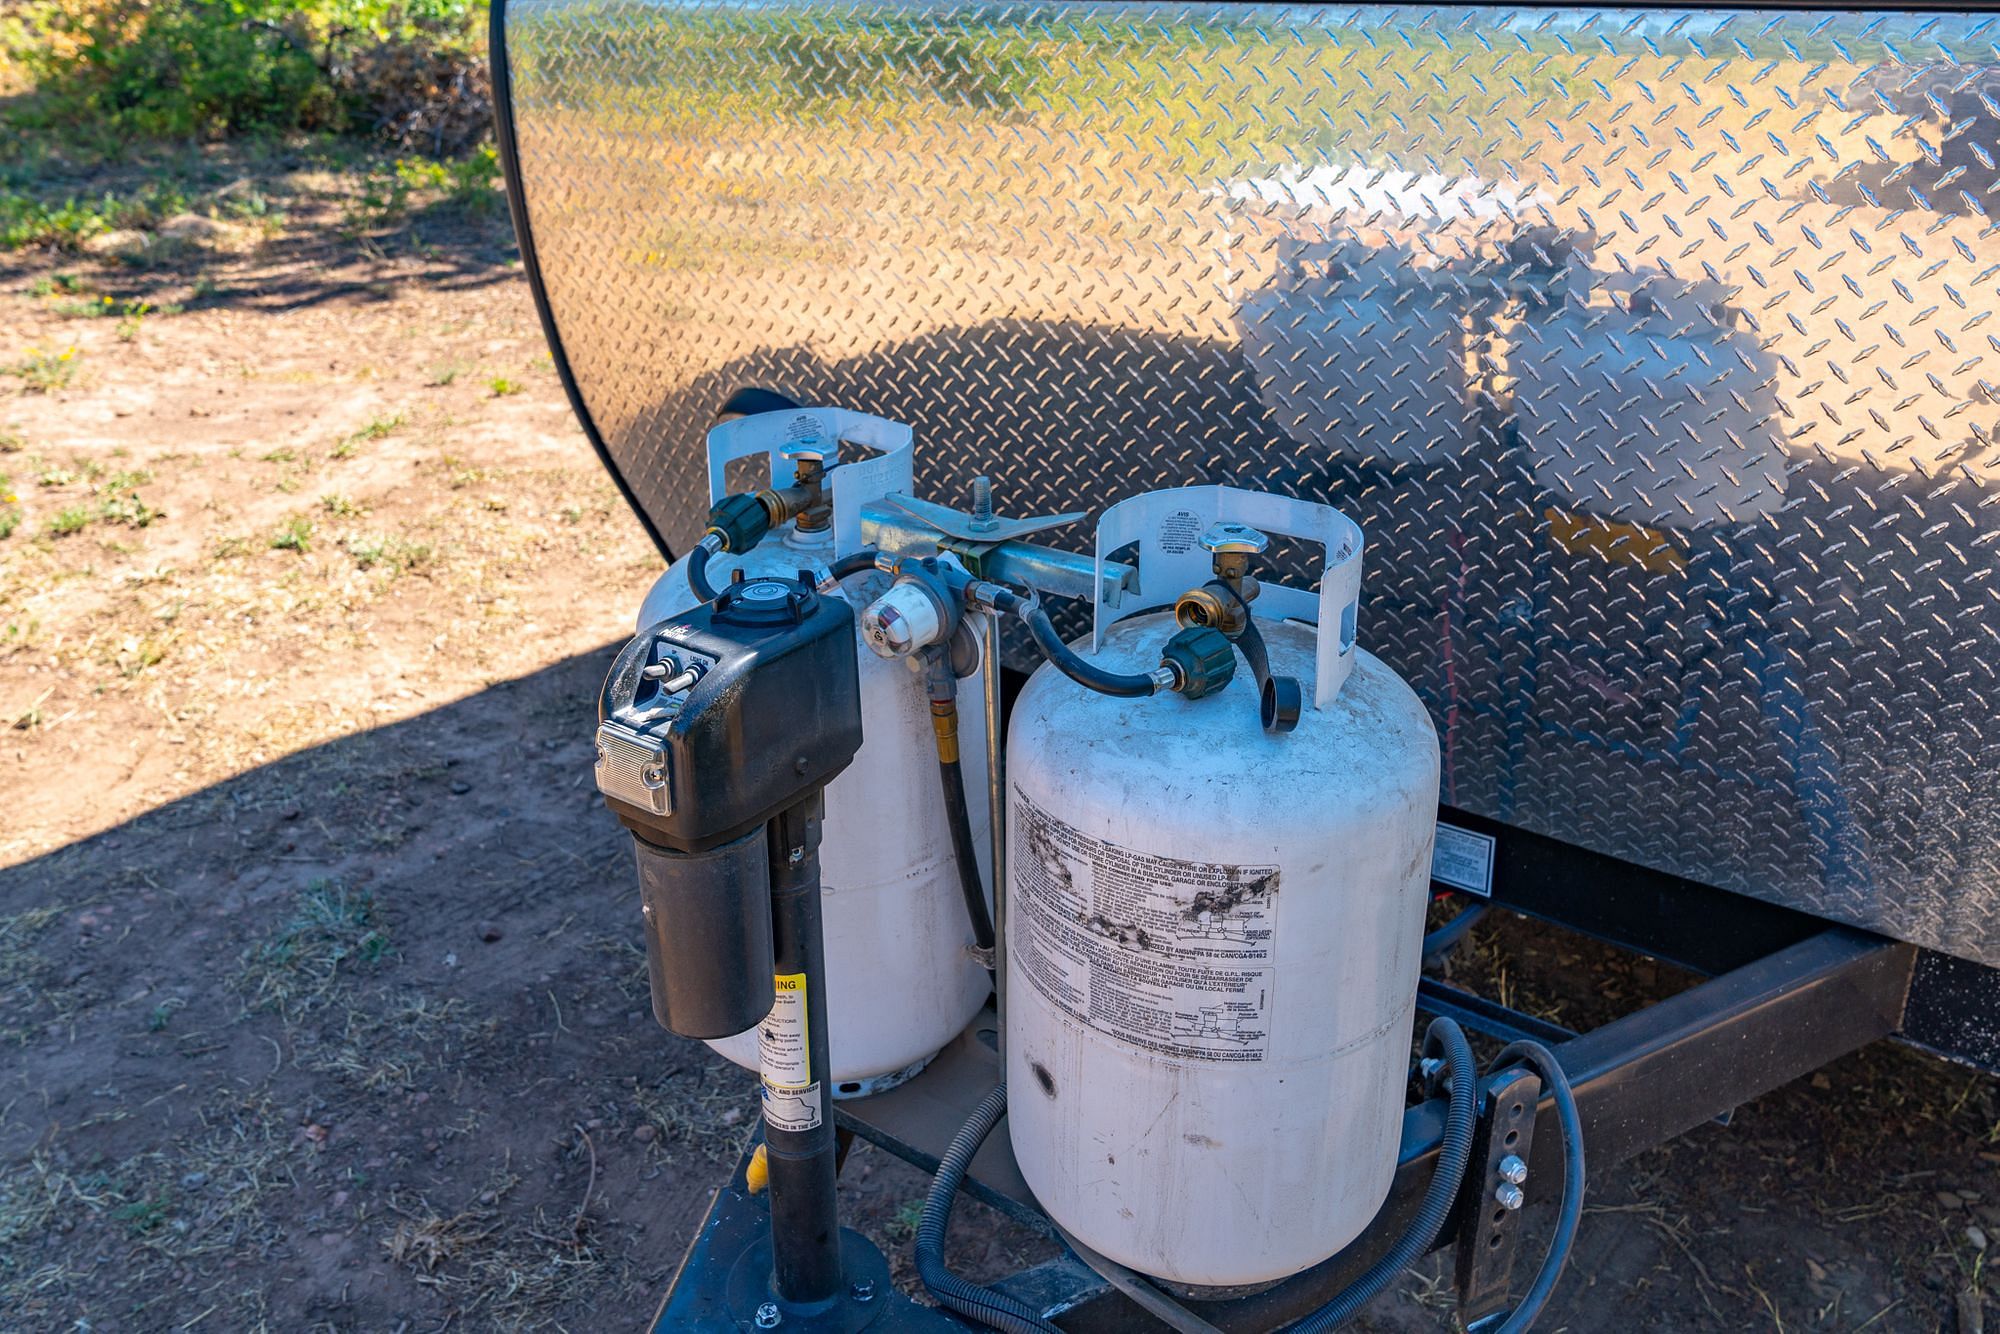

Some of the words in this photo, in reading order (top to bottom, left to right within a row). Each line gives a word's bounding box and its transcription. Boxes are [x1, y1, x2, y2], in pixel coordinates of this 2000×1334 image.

[690, 655, 702, 663] LIGHT
[1088, 851, 1105, 864] STORE
[1105, 858, 1131, 872] CYLINDER
[1142, 870, 1170, 882] BUILDING,
[1171, 876, 1196, 886] GARAGE
[1098, 850, 1106, 858] OR
[1105, 852, 1131, 866] DISPOSAL
[1140, 862, 1153, 871] THIS
[1153, 866, 1182, 877] CYLINDER
[1102, 844, 1125, 857] LEAKING
[1125, 851, 1145, 863] LP-GAS
[1146, 857, 1158, 866] MAY
[1208, 866, 1242, 876] EXPLON
[1092, 861, 1108, 871] WHEN
[1108, 866, 1146, 882] CONNECTING
[1110, 948, 1135, 960] CONTACT
[1152, 960, 1177, 972] FLAMME,
[1178, 966, 1197, 974] TOUTE
[1174, 948, 1205, 957] ANSI/NFPA
[1119, 962, 1158, 977] FOURNISSEUR
[1161, 974, 1192, 984] N'UTILISER
[1130, 959, 1164, 974] RÉPARATION
[1174, 970, 1191, 979] POUR
[1200, 974, 1245, 982] DÉBARRASSER
[1159, 979, 1185, 988] GARAGE
[1147, 1040, 1158, 1048] DES
[791, 1083, 819, 1096] SERVICED
[810, 1119, 820, 1128] USA
